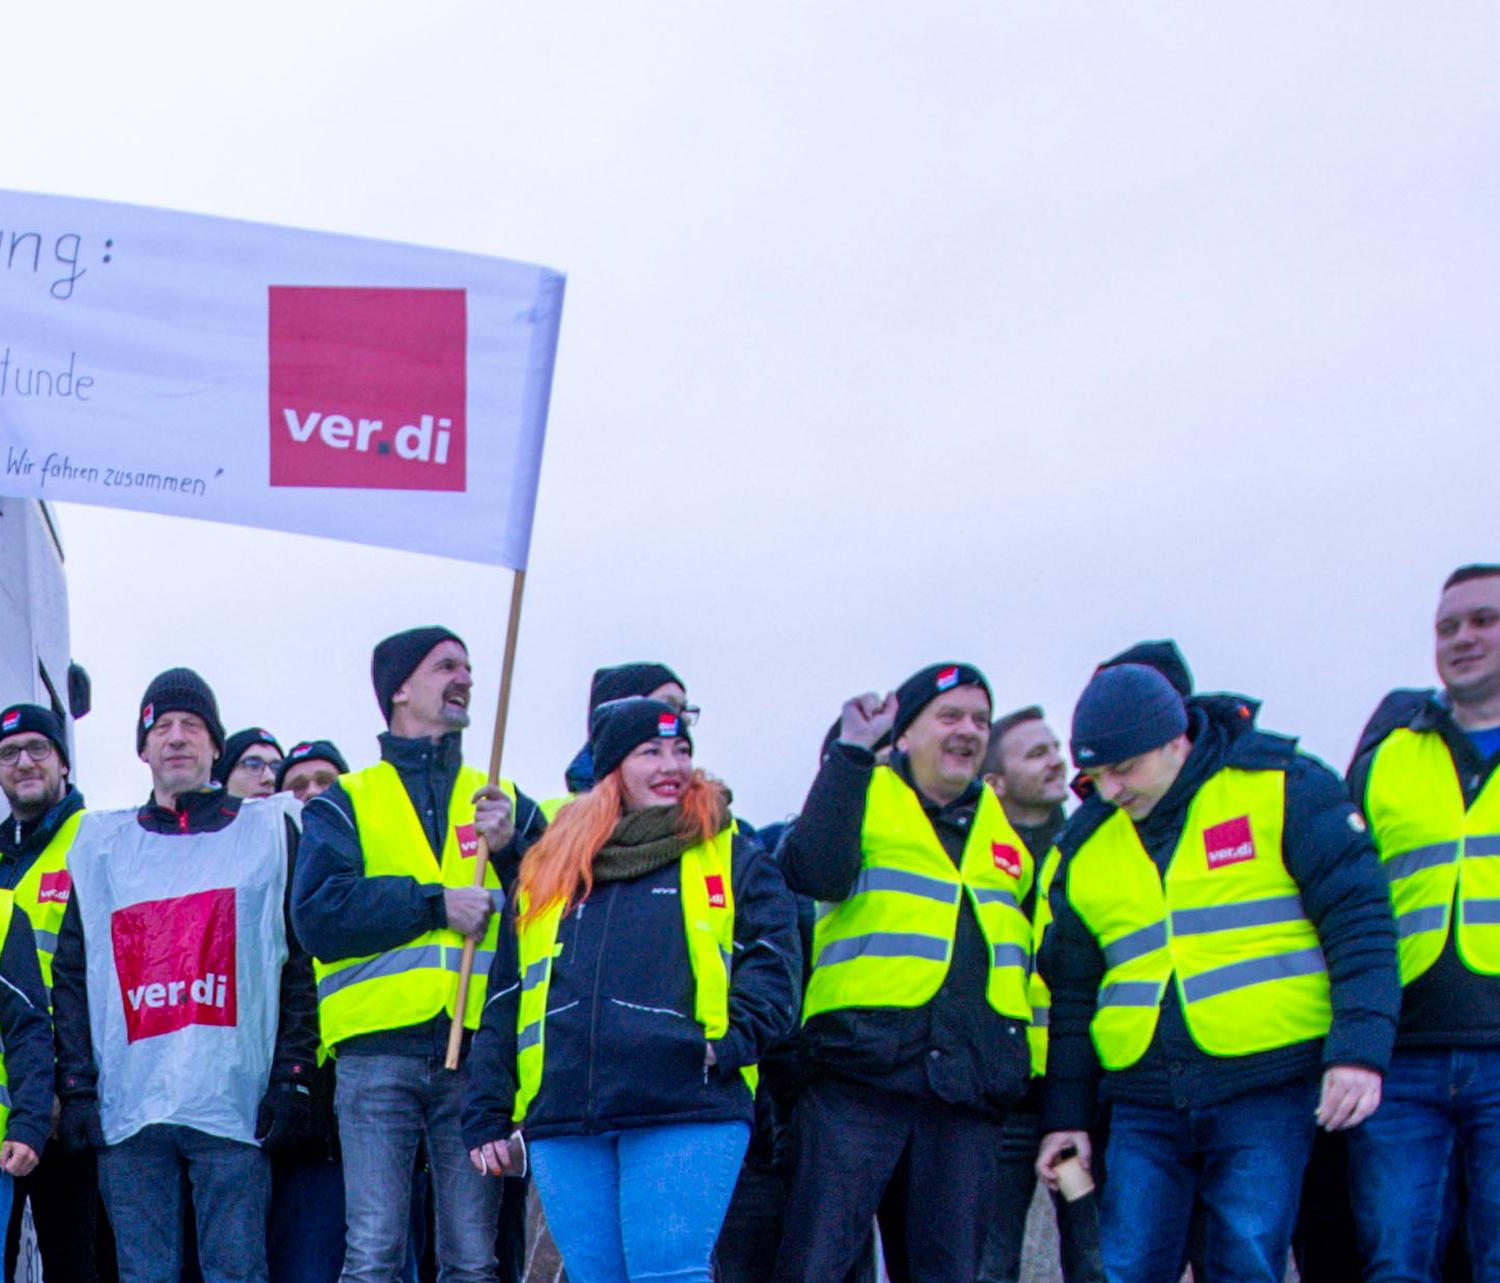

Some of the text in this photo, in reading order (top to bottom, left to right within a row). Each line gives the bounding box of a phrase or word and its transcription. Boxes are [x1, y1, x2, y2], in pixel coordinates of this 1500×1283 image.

[283, 407, 453, 465] ver.di
[41, 452, 100, 488] fahren
[123, 972, 228, 1011] ver.di
